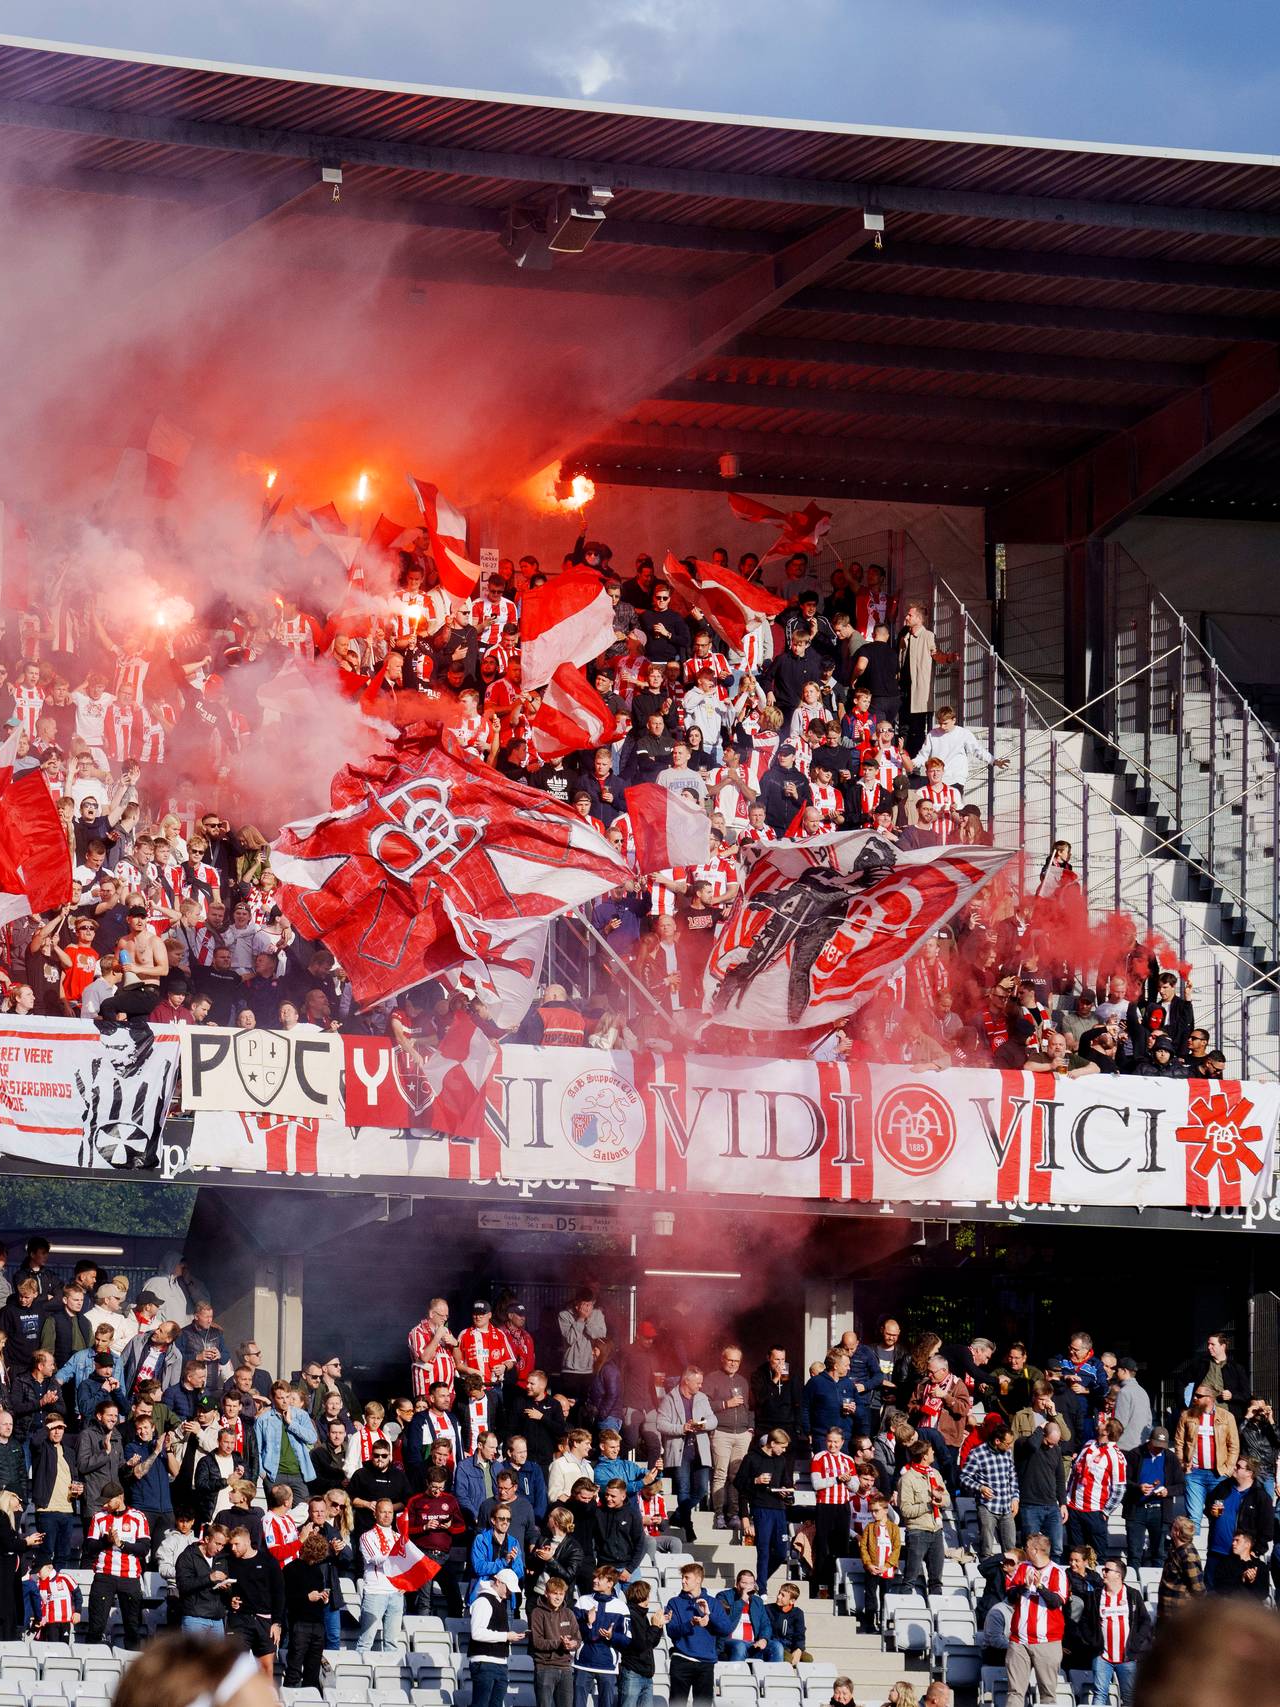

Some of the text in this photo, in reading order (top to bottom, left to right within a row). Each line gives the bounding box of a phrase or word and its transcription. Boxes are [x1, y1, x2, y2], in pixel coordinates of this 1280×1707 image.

[24, 1048, 54, 1064] VÆRE
[648, 1084, 864, 1166] VIDI
[968, 1097, 1166, 1175] VICI
[909, 1143, 925, 1152] 1885
[556, 1217, 576, 1231] D5
